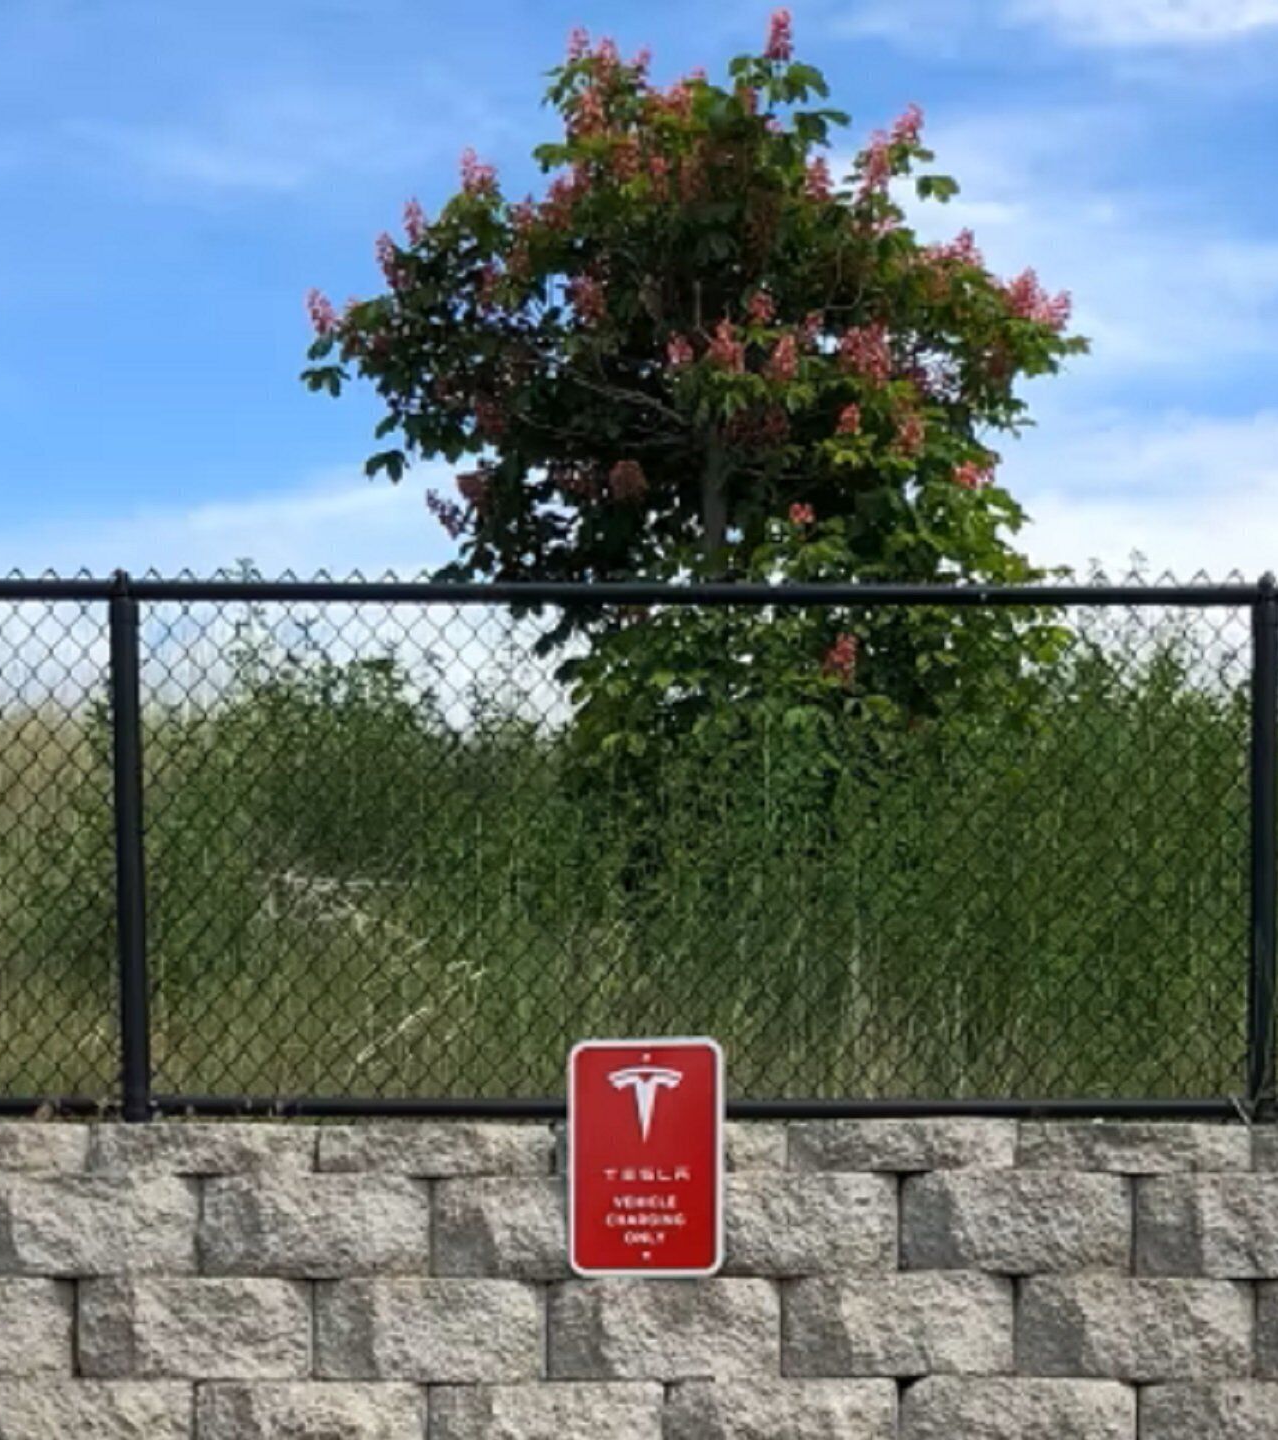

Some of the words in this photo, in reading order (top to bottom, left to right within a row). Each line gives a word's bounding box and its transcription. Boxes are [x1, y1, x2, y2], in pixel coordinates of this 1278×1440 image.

[603, 1167, 691, 1181] TESLA
[612, 1194, 677, 1209] VEHICLE
[604, 1212, 687, 1227] CHARGING
[623, 1230, 666, 1245] ONLY
